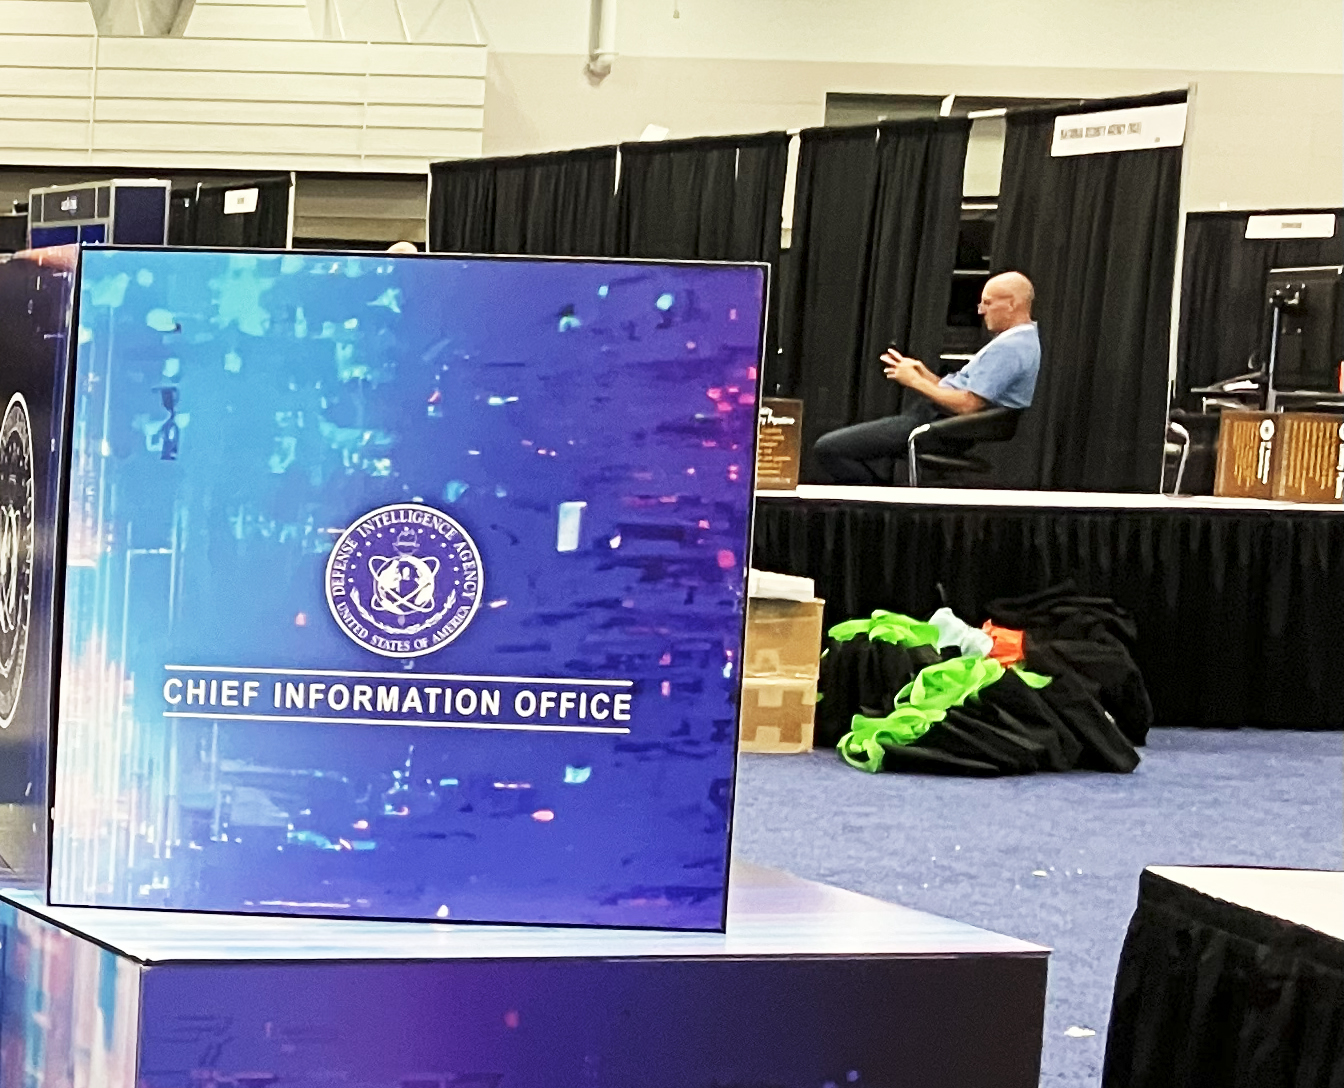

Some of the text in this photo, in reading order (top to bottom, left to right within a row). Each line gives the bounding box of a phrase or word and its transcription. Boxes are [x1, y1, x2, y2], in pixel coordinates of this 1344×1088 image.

[331, 509, 478, 601] DEFENSE INTELLIGENCE AGENCY
[336, 602, 472, 652] UNITED STATES OF AMERICA
[162, 677, 632, 722] CHIEF INFORMATION OFFICE
